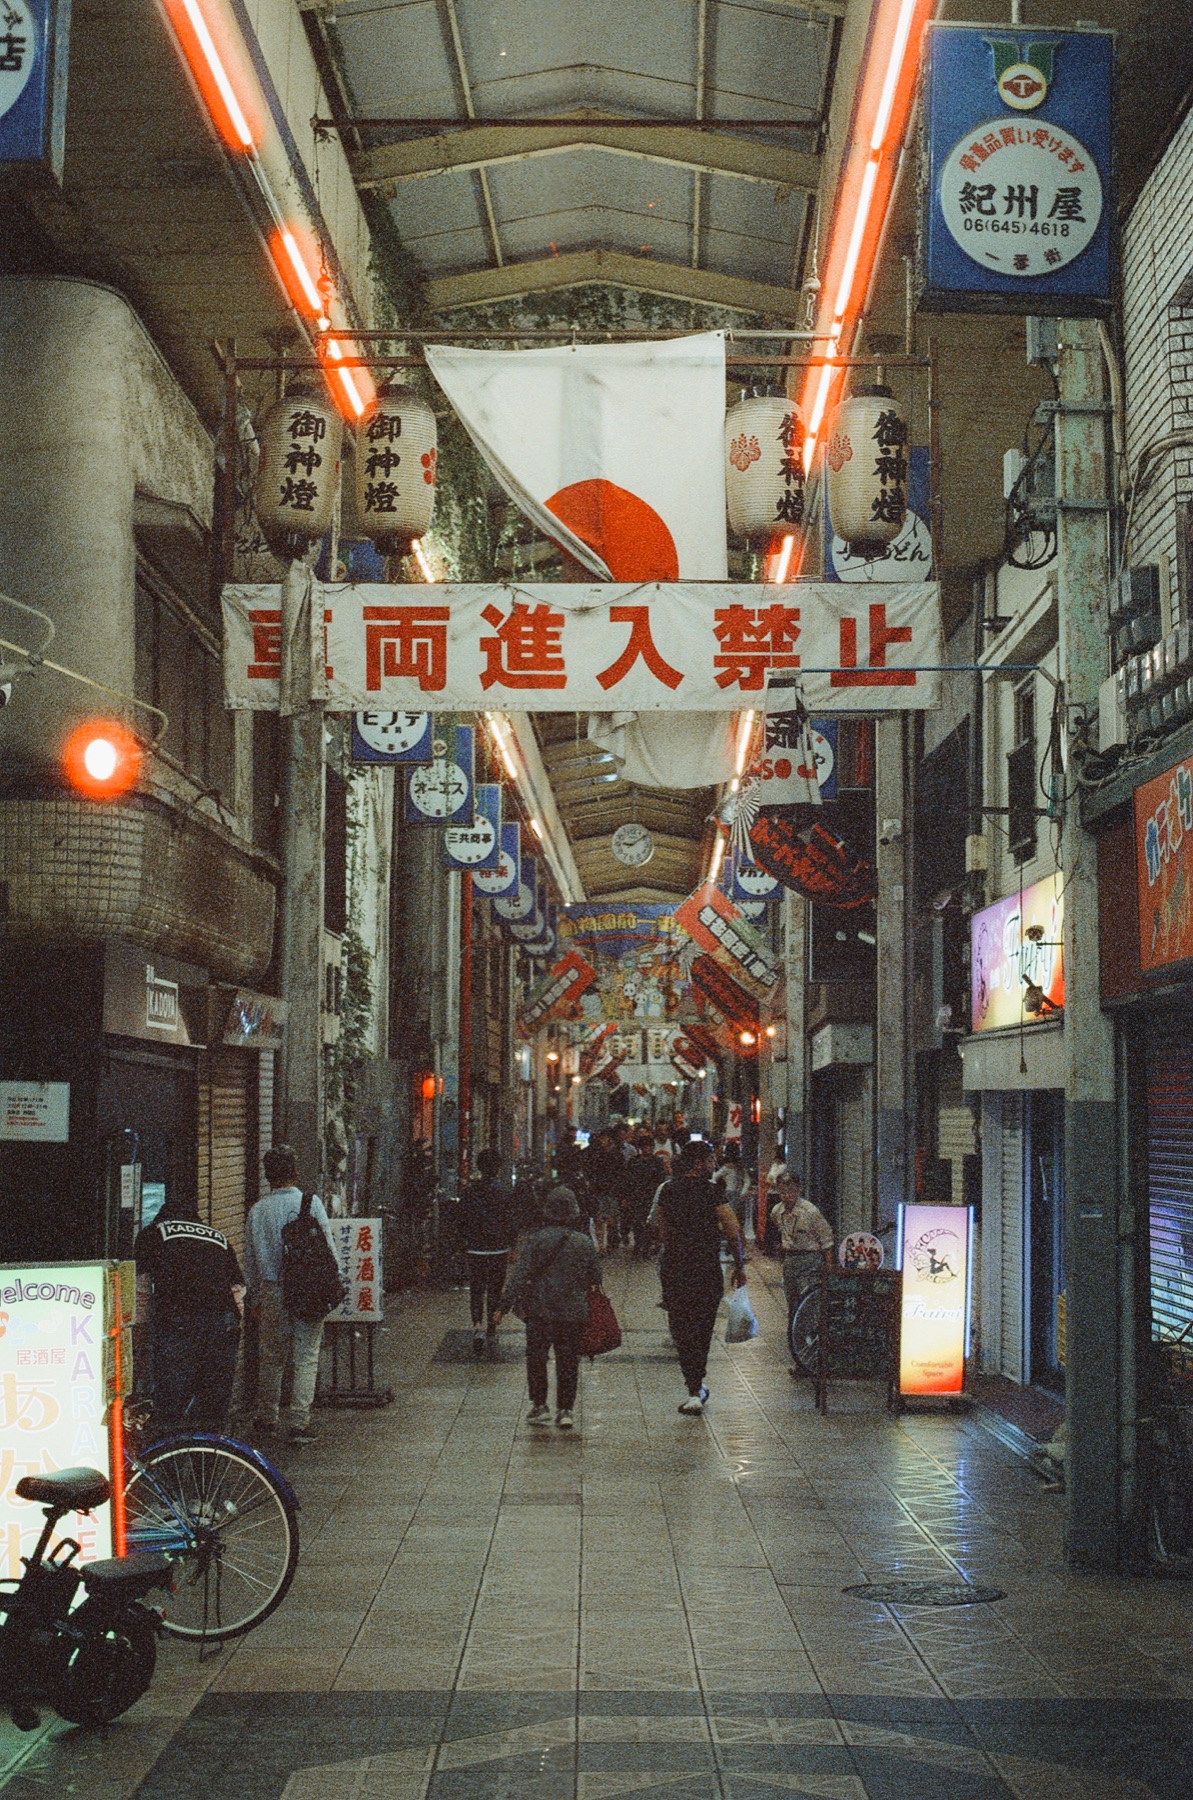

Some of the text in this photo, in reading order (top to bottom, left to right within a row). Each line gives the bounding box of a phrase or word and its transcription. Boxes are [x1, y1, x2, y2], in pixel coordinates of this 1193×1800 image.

[959, 126, 1085, 174] 骨董品買い受けます
[959, 181, 1086, 224] 紀州屋
[963, 218, 1070, 238] 06(645)4618
[985, 247, 1062, 271] 一番街
[279, 410, 326, 512] 御神燈
[364, 412, 402, 514] 御神燈
[415, 782, 465, 796] オーエス
[166, 1224, 223, 1240] KADOYA
[354, 1225, 375, 1313] 居酒屋
[0, 1278, 96, 1310] elcome
[16, 1347, 67, 1366] 居酒屋
[69, 1314, 100, 1562] KARAKE
